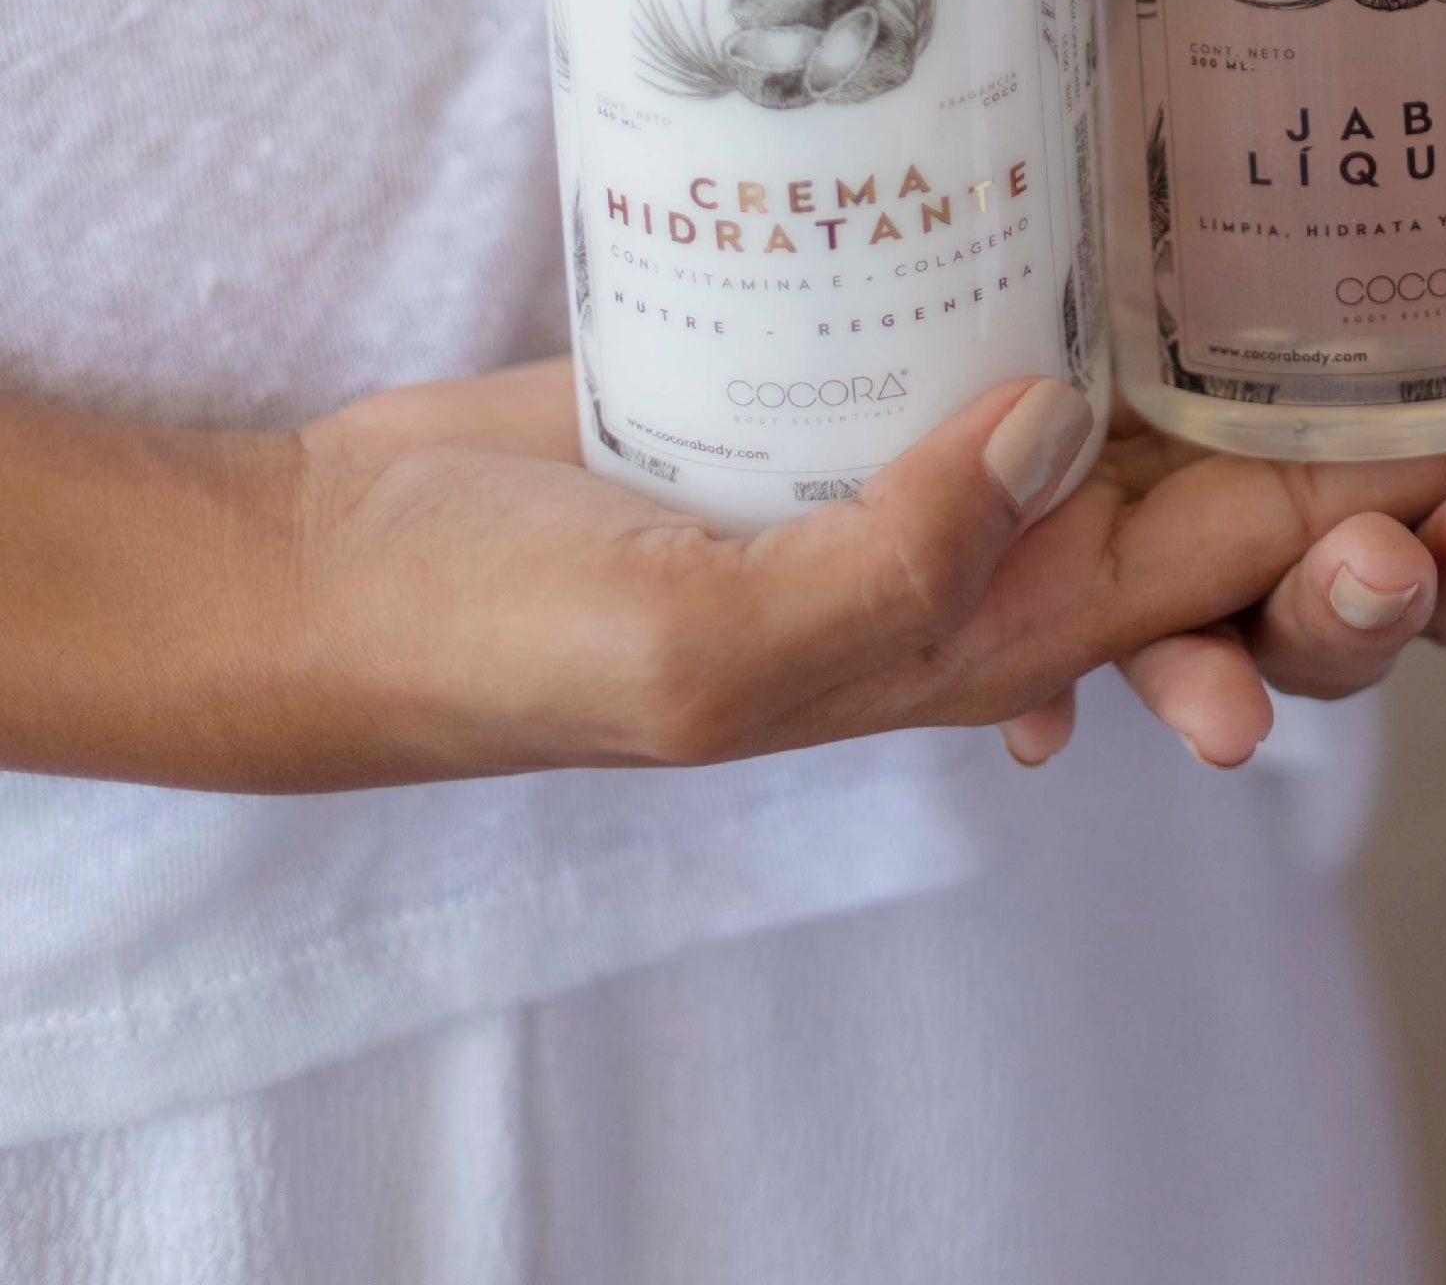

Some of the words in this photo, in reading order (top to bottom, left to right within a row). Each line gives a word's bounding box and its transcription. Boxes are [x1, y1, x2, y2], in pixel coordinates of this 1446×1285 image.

[1248, 47, 1296, 60] NETO
[982, 82, 1018, 107] COCO
[607, 160, 1028, 254] HIDRATANTE
[689, 163, 931, 215] CREMA
[1306, 218, 1422, 237] HIDRATA
[610, 243, 659, 275] CON:
[673, 268, 811, 292] VITAMINA
[832, 275, 844, 289] E
[894, 217, 1029, 278] COLAGENO
[613, 290, 724, 335] NUTRE
[818, 264, 1033, 337] REGENERA
[1208, 344, 1368, 367] www.cocorabody.com
[626, 416, 770, 461] www.cocorabody.com
